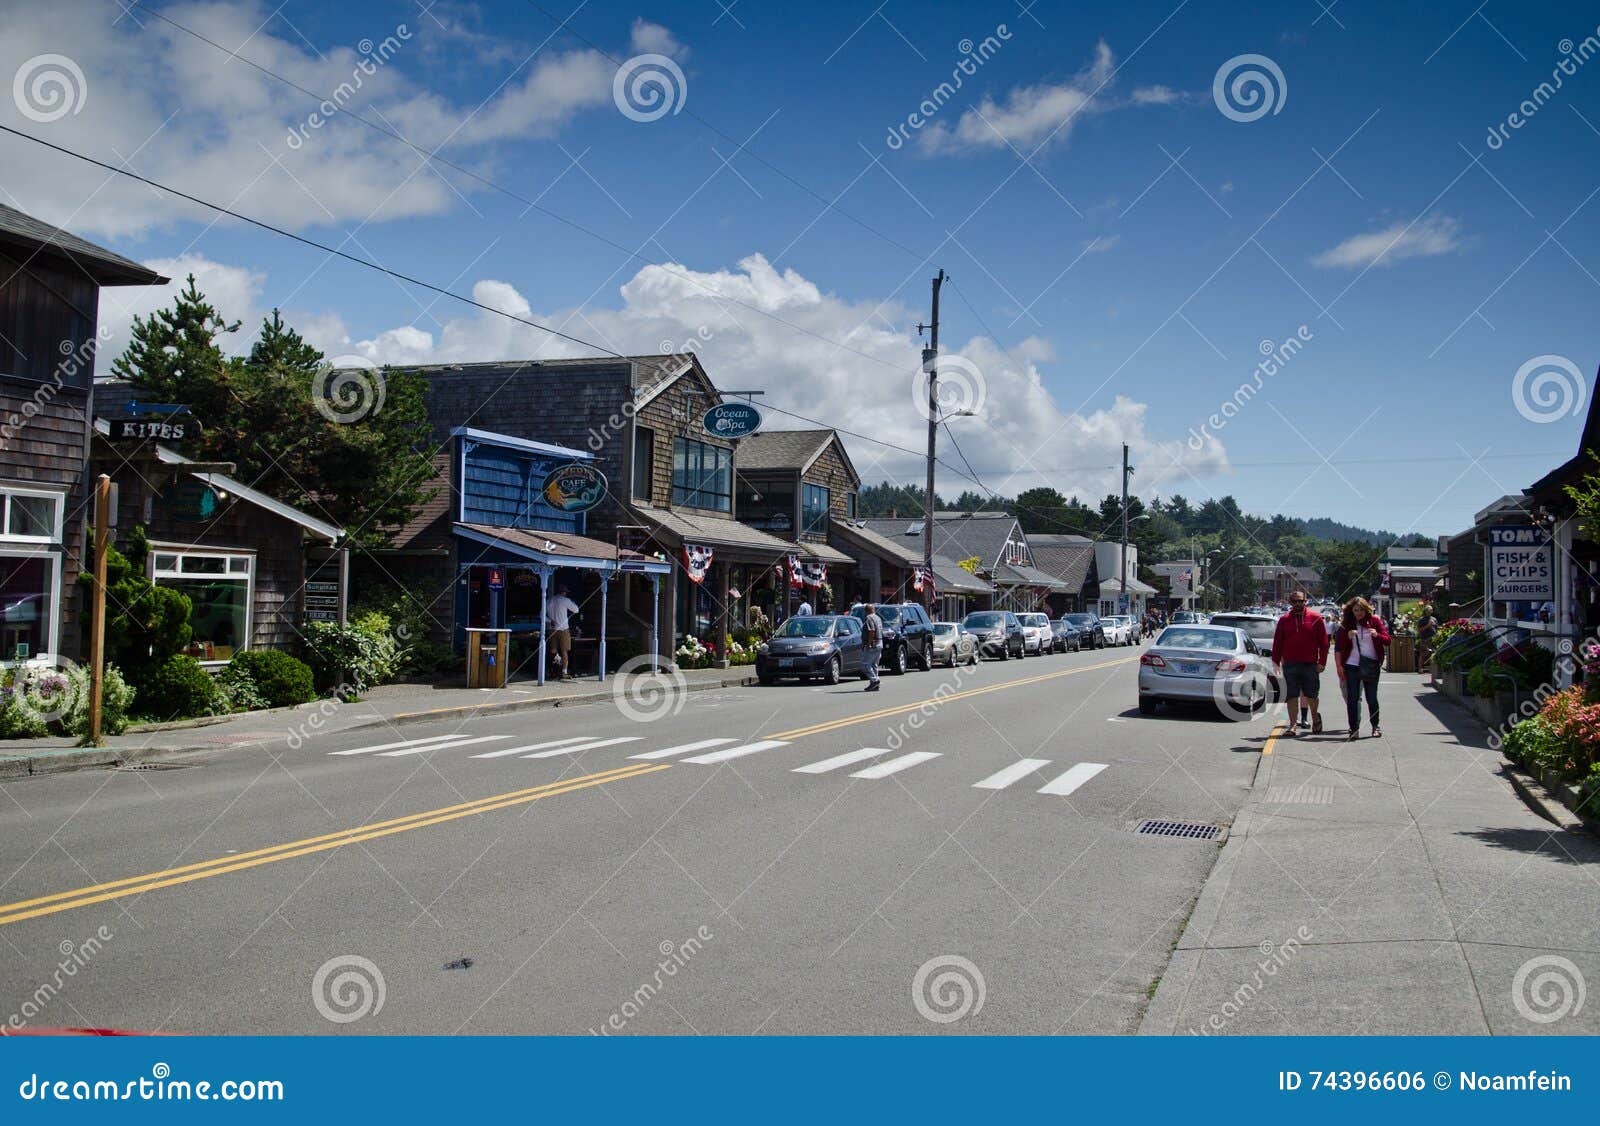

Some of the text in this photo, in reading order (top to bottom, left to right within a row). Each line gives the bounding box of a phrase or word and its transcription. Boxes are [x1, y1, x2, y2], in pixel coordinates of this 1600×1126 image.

[714, 407, 749, 418] Ocean
[122, 423, 185, 439] KITES
[726, 419, 746, 432] Spa
[1491, 529, 1552, 543] TOM'S
[1496, 552, 1546, 564] FISH &
[1496, 566, 1548, 578] CHIPS
[1497, 584, 1549, 593] BURGERS
